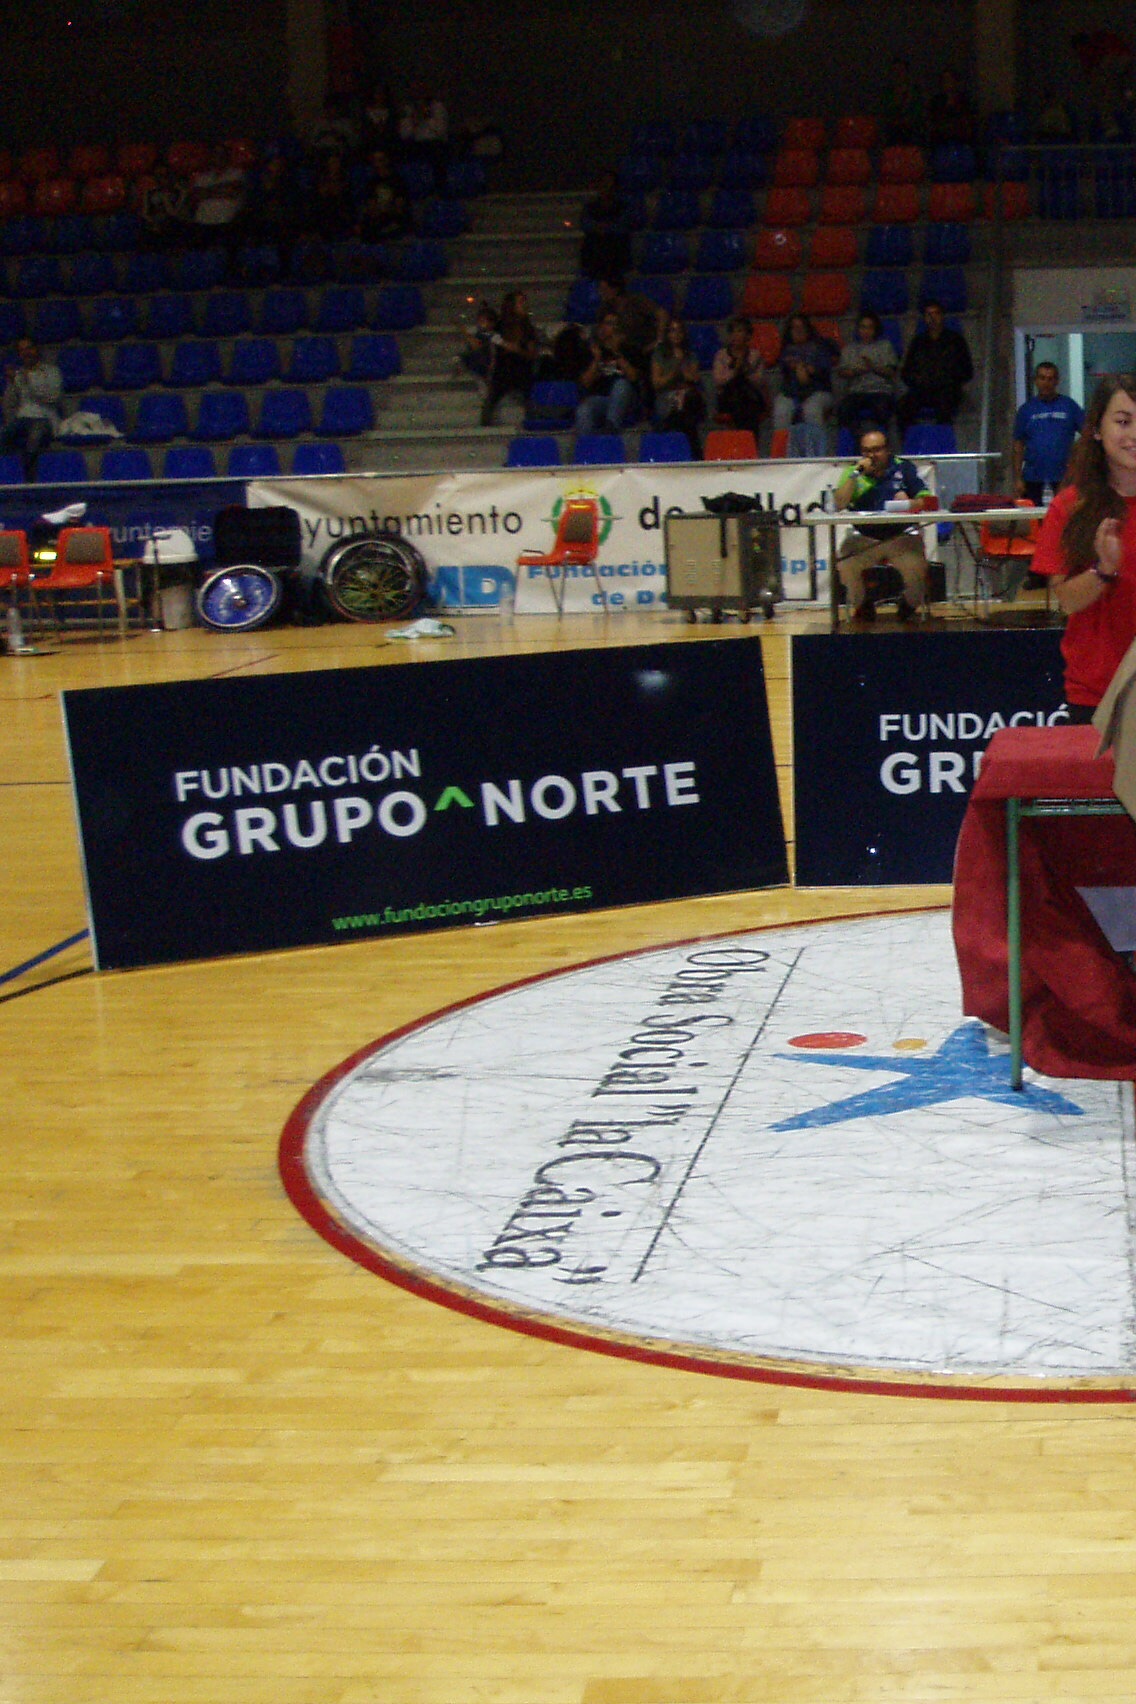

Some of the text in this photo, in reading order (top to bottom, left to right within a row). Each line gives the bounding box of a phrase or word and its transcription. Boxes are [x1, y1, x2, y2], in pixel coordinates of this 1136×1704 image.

[303, 502, 522, 549] yuntamiento
[174, 745, 422, 803] FUNDACIÓN
[180, 760, 702, 861] GRUPO NORTE
[332, 882, 594, 931] www.fundaciongruponorte.es
[658, 947, 770, 1007] Obra
[590, 1012, 734, 1099] Social
